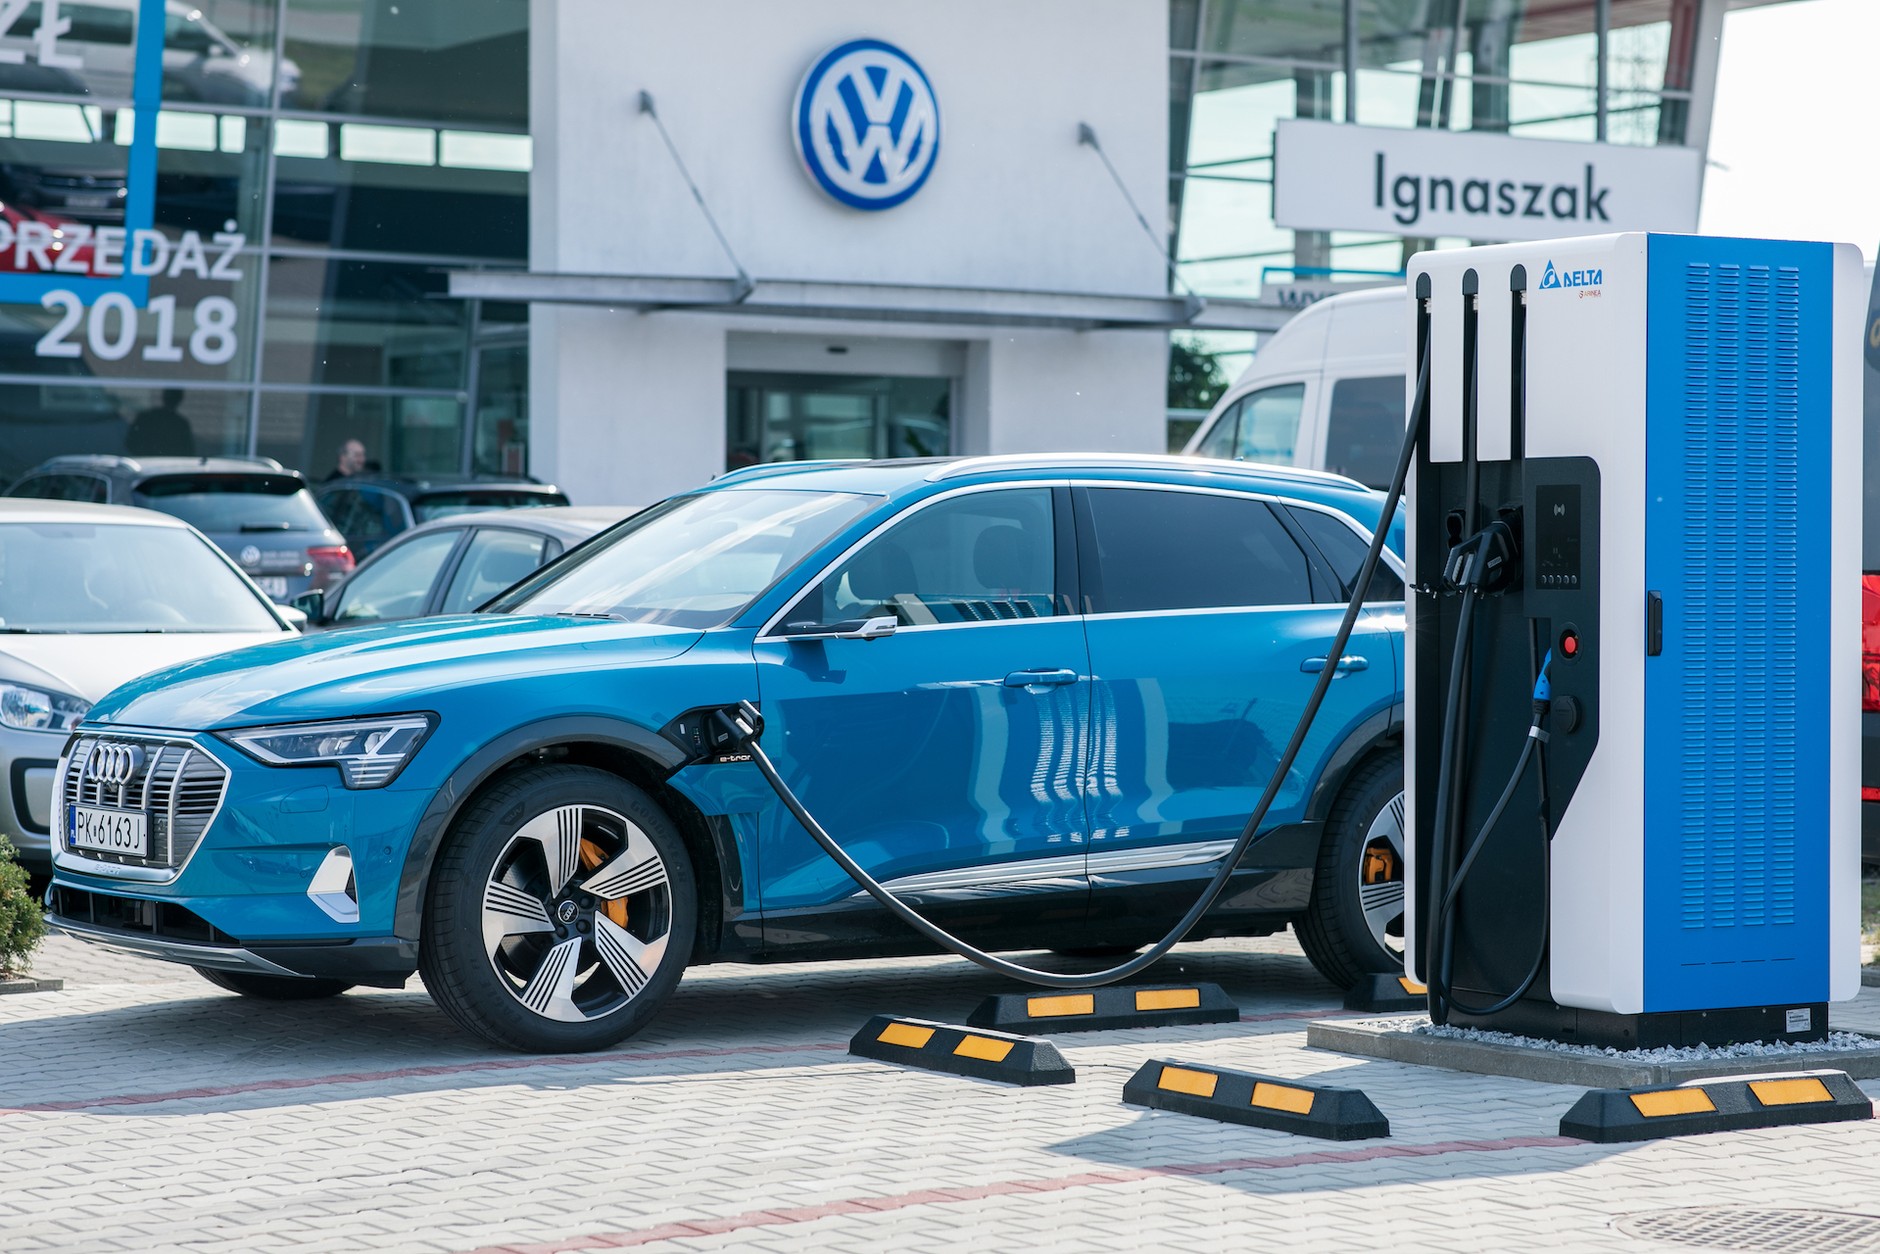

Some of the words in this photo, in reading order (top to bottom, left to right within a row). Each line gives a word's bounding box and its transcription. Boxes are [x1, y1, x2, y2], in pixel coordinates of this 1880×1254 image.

[1375, 152, 1610, 225] Ignaszak
[1563, 269, 1603, 288] DELTA
[35, 288, 238, 365] 2018
[77, 811, 93, 844] PK
[98, 814, 140, 849] 6163J
